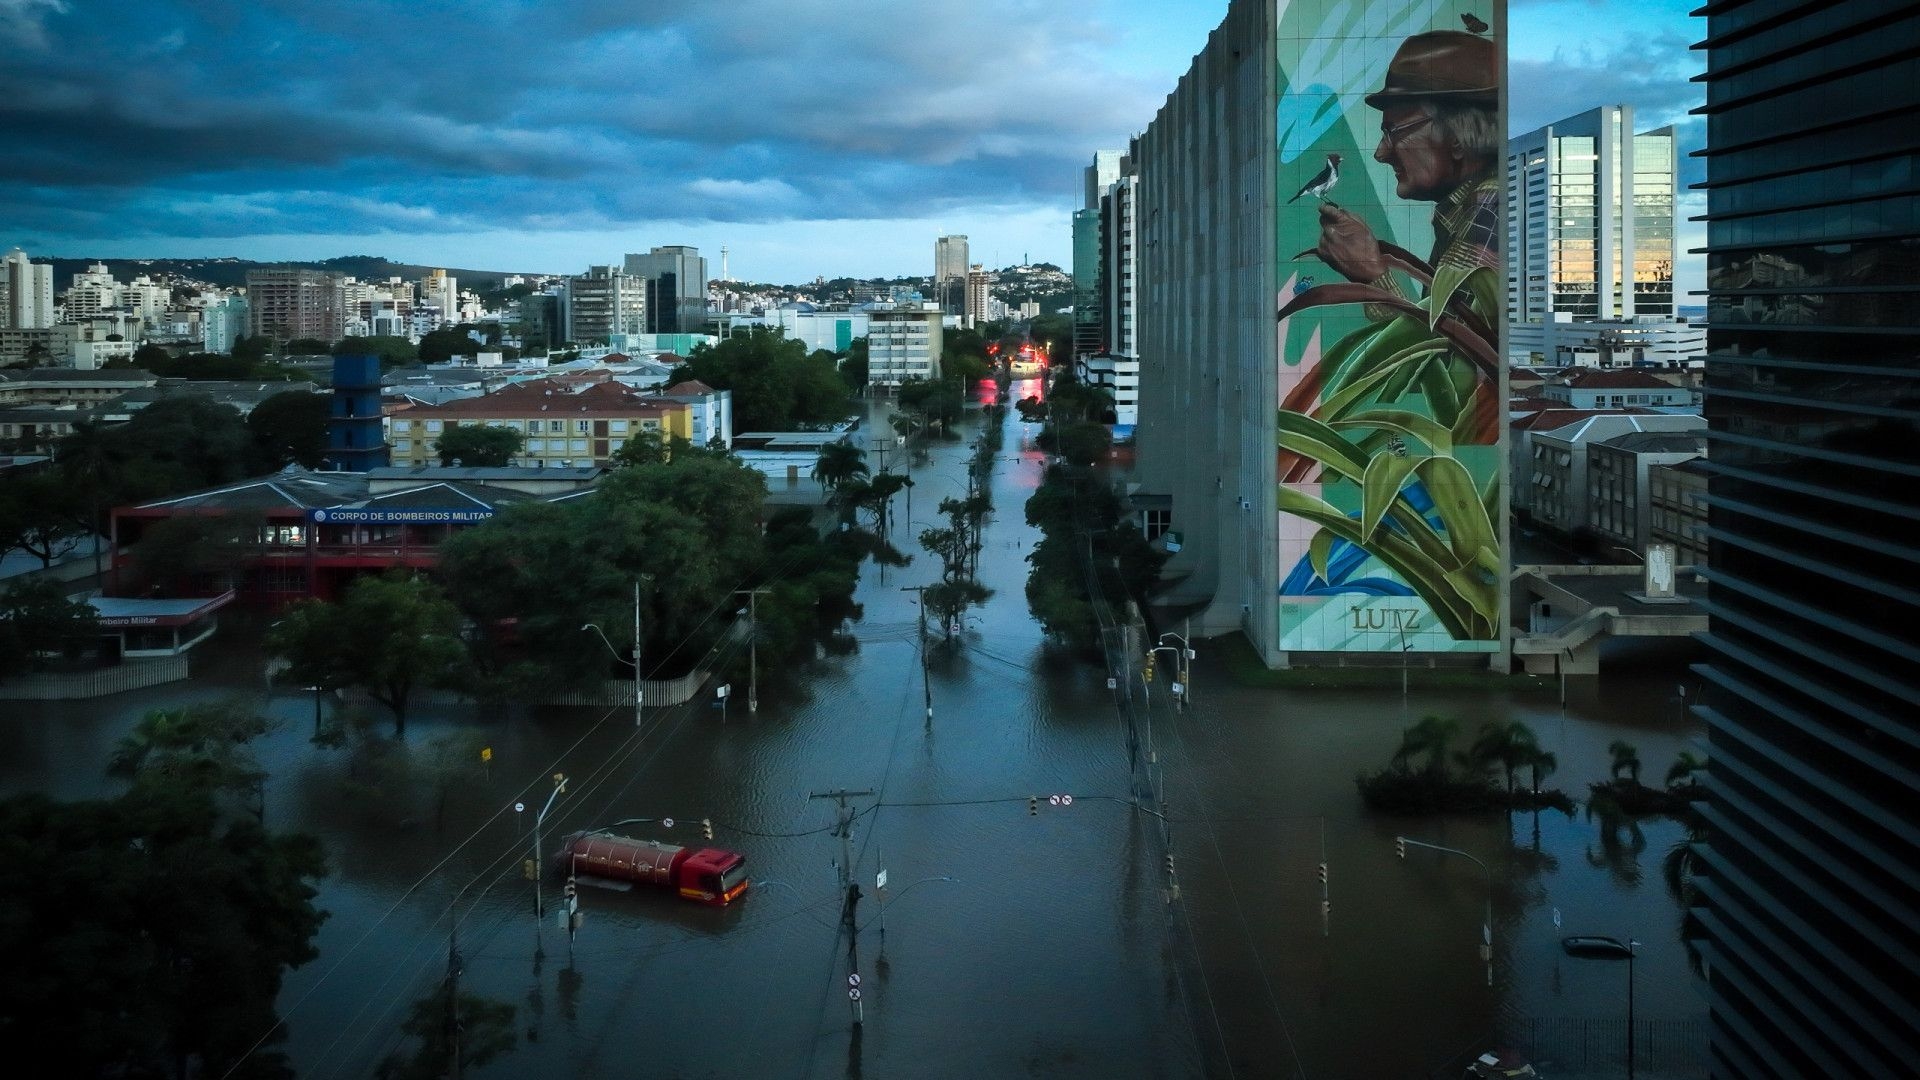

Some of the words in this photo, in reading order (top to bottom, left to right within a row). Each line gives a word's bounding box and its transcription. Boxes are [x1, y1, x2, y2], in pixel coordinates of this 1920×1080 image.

[331, 512, 368, 521] CORPO
[371, 512, 384, 521] DE
[387, 512, 450, 521] BOMBEIROS
[131, 616, 158, 625] Militar
[1352, 607, 1420, 630] LUTZ
